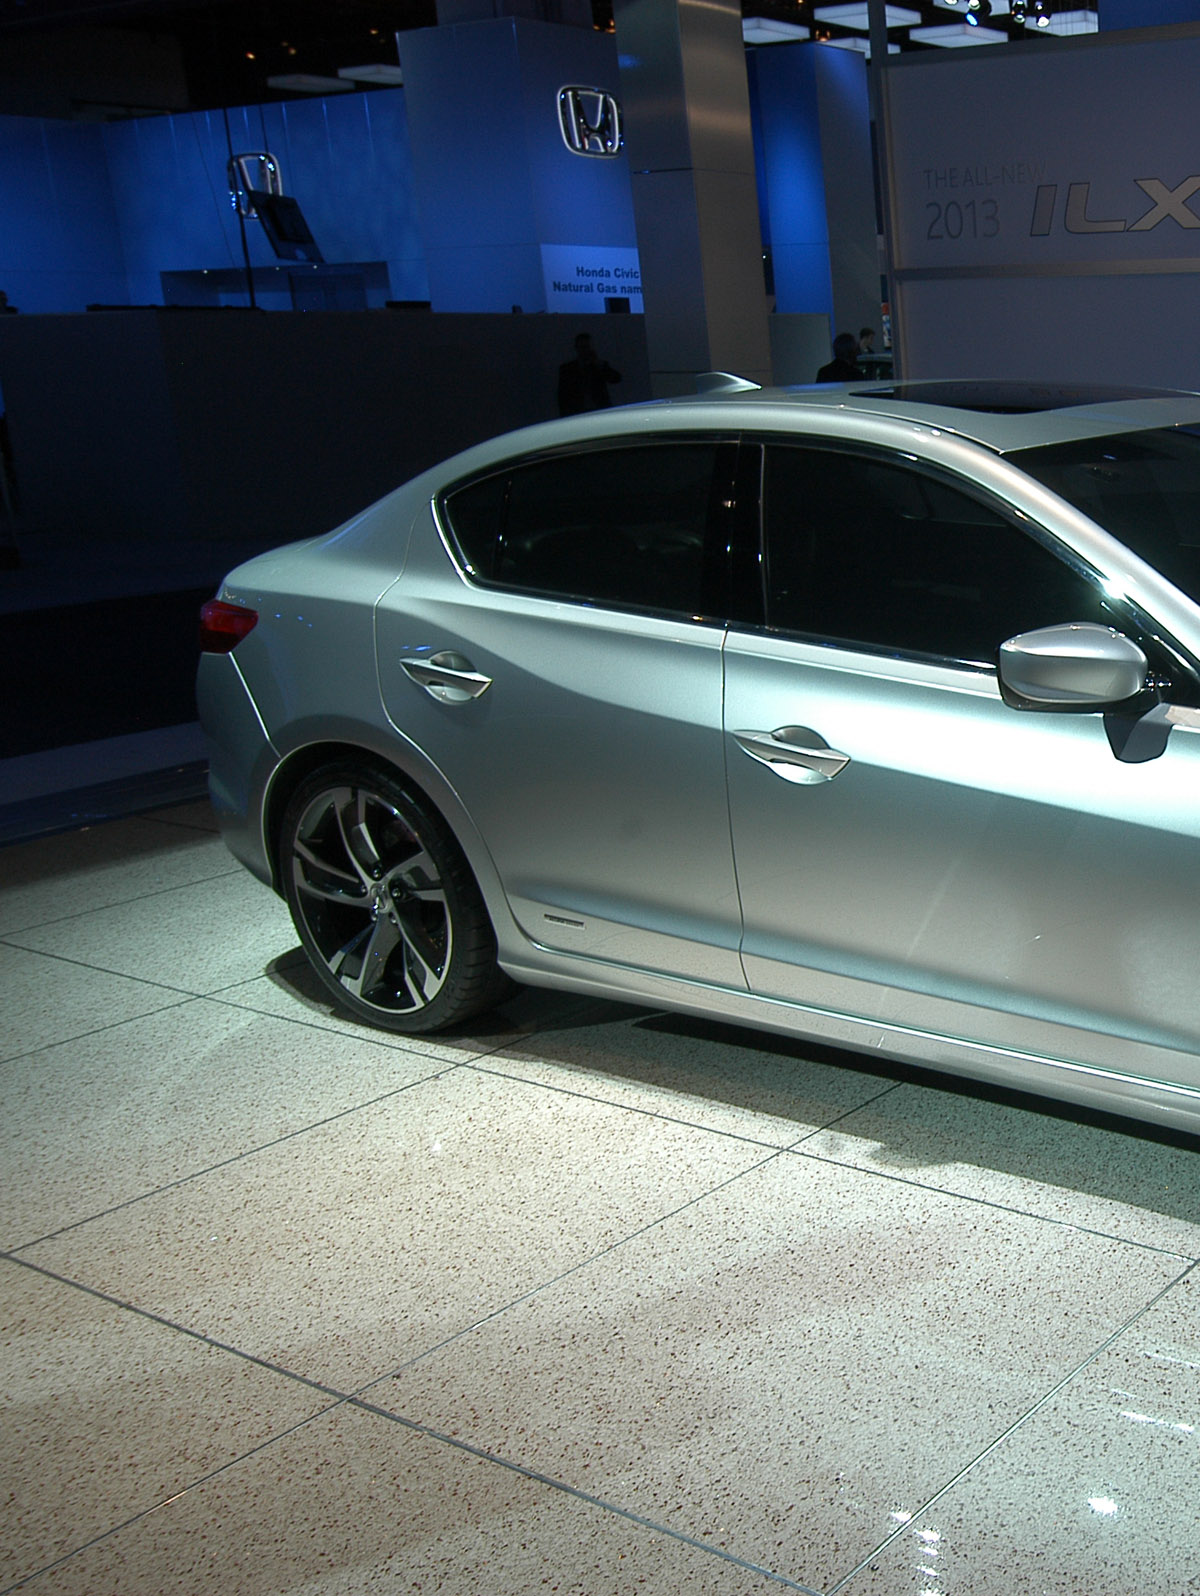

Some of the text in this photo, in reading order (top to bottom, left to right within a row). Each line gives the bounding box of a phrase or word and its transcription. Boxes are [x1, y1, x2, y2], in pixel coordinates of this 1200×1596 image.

[923, 160, 1048, 190] THE ALL-NEW
[926, 199, 1000, 240] 2013
[576, 266, 640, 279] Honda Civic
[553, 282, 594, 293] Natural
[597, 282, 617, 294] Gas
